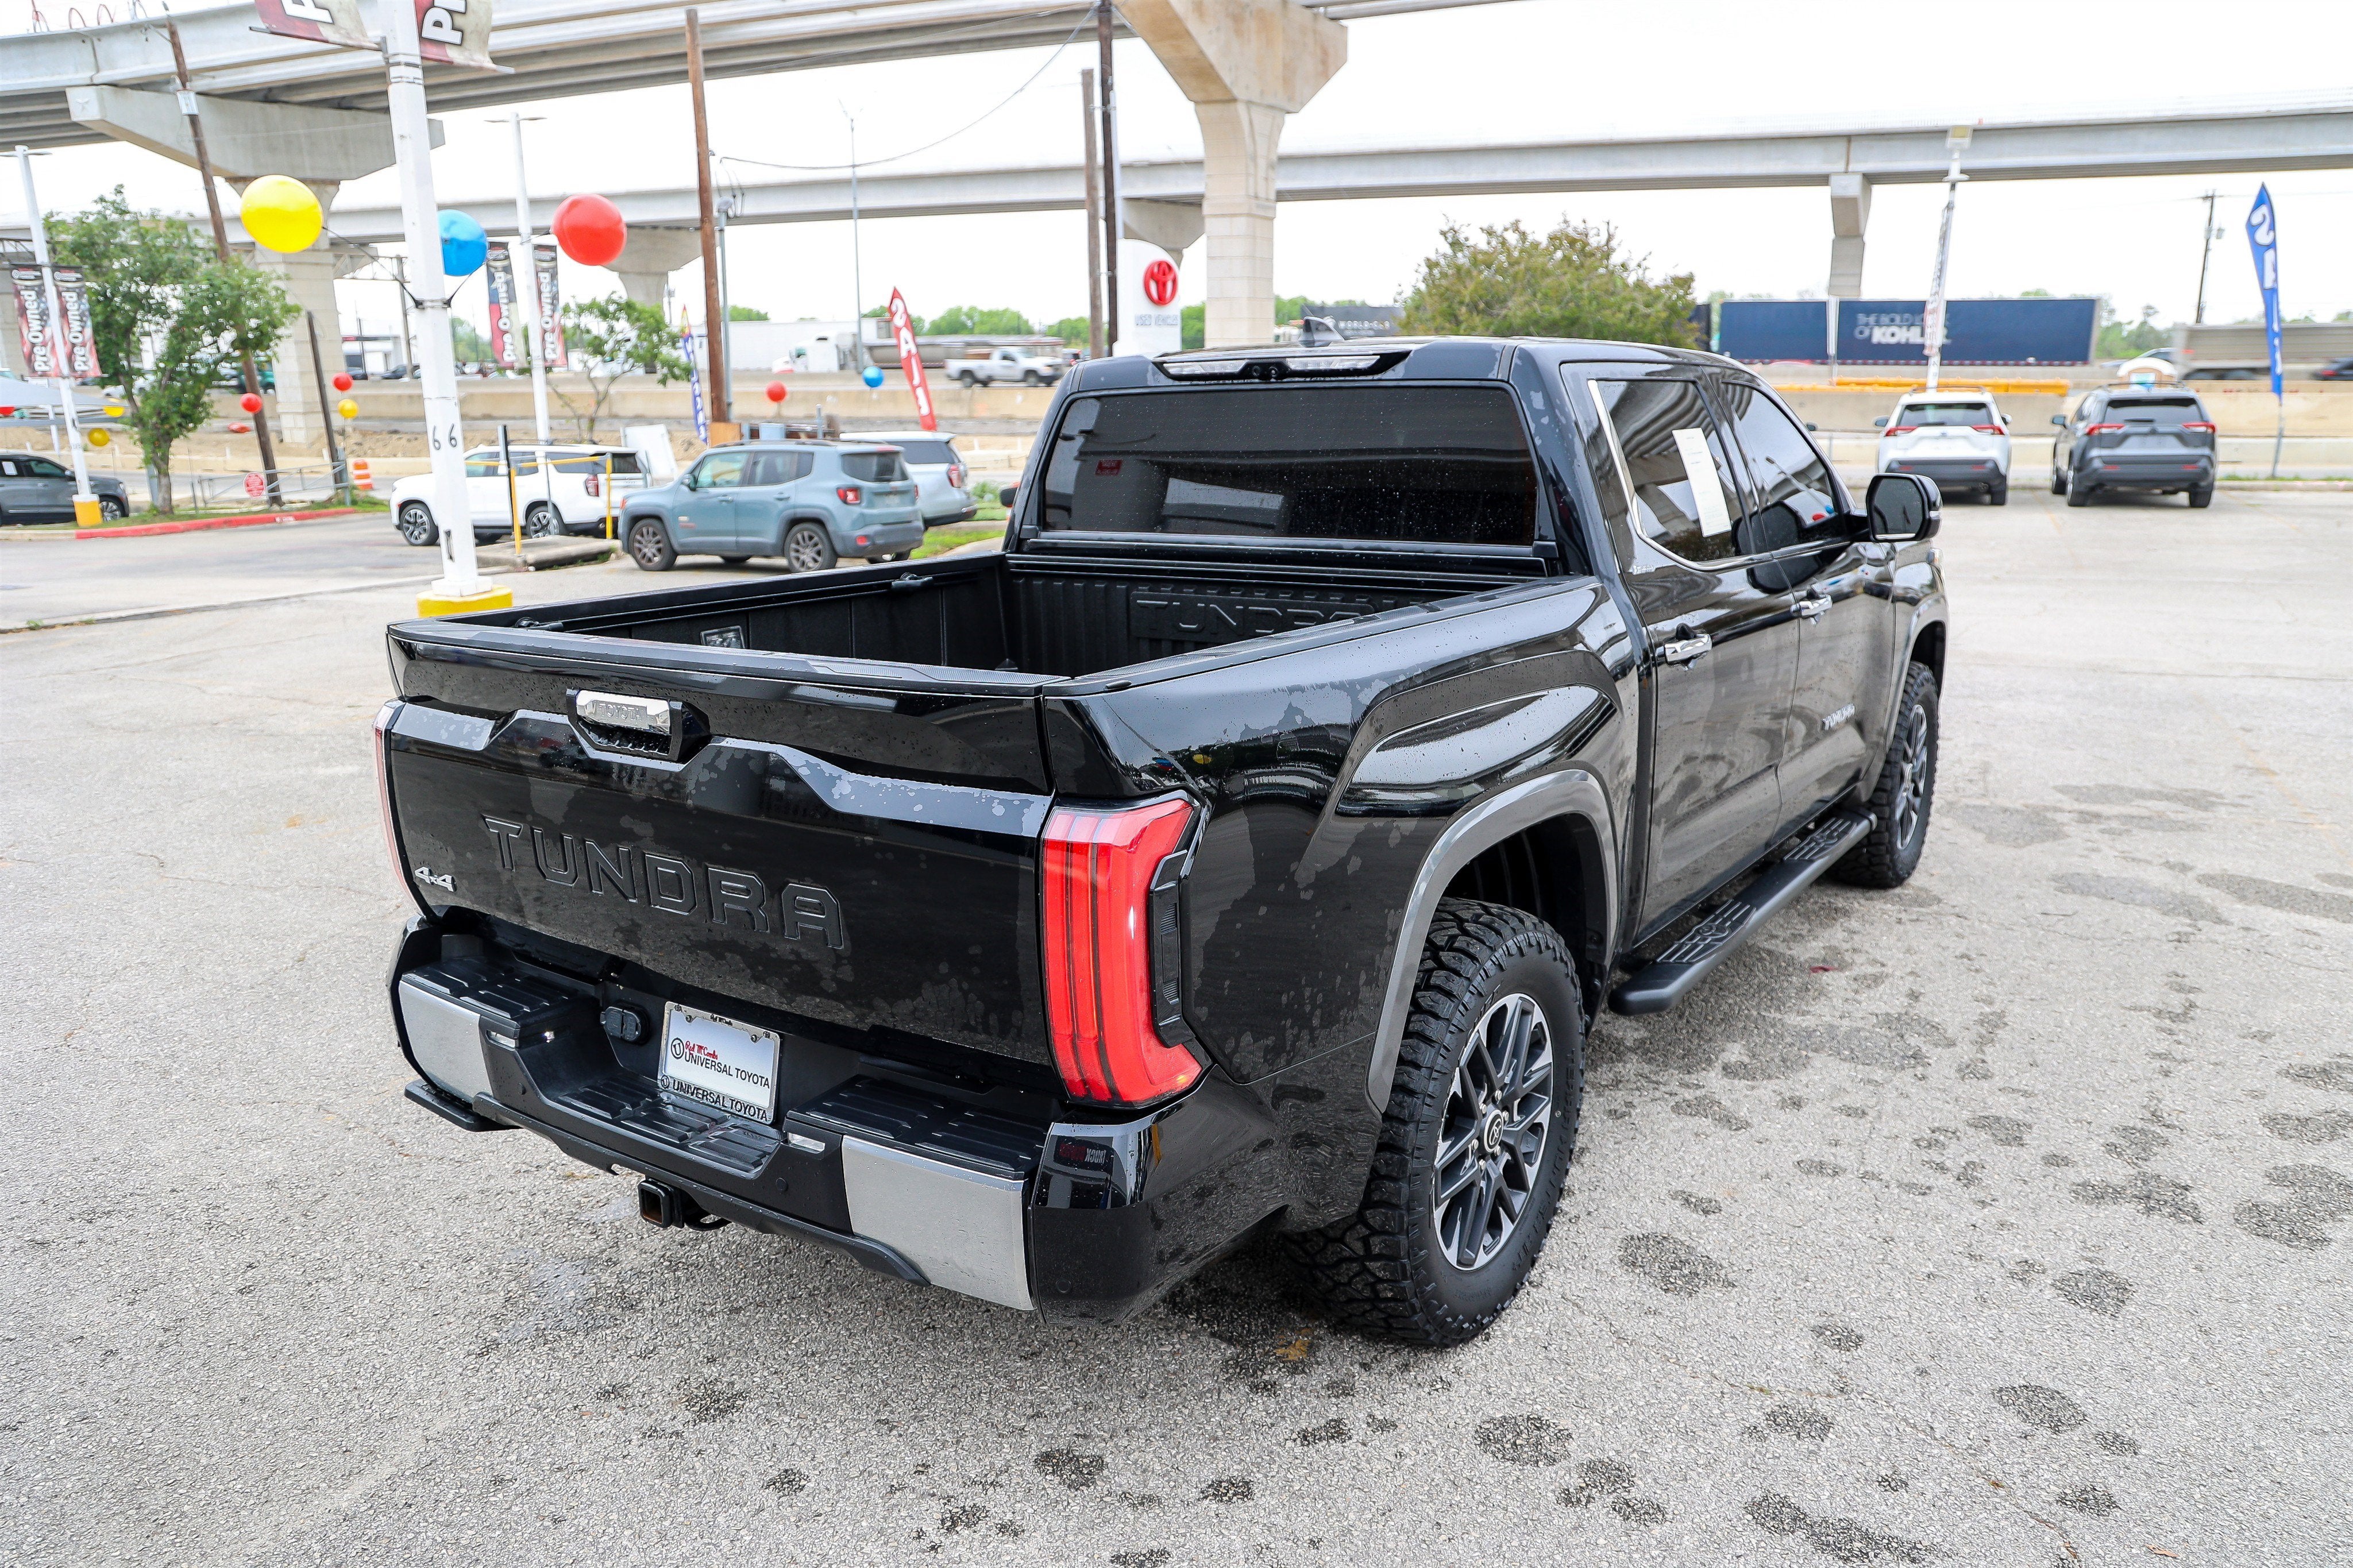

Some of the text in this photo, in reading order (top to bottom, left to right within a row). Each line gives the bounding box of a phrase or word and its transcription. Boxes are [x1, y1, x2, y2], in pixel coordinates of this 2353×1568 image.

[20, 291, 45, 343] Owned
[61, 291, 84, 343] Owned
[494, 272, 511, 331] Owned
[538, 272, 553, 331] Owned
[33, 346, 51, 371] Pre
[73, 346, 90, 371] Pre
[503, 333, 516, 362] Pre
[544, 332, 557, 360] Pre
[599, 702, 643, 721] TOYOTA
[414, 866, 454, 892] 4x4
[482, 815, 844, 949] TUNDRA
[685, 1040, 696, 1055] Red
[685, 1051, 770, 1089] UNIVERSAL TOYOTA
[673, 1079, 768, 1121] UNIVERSAL TOYOTA
